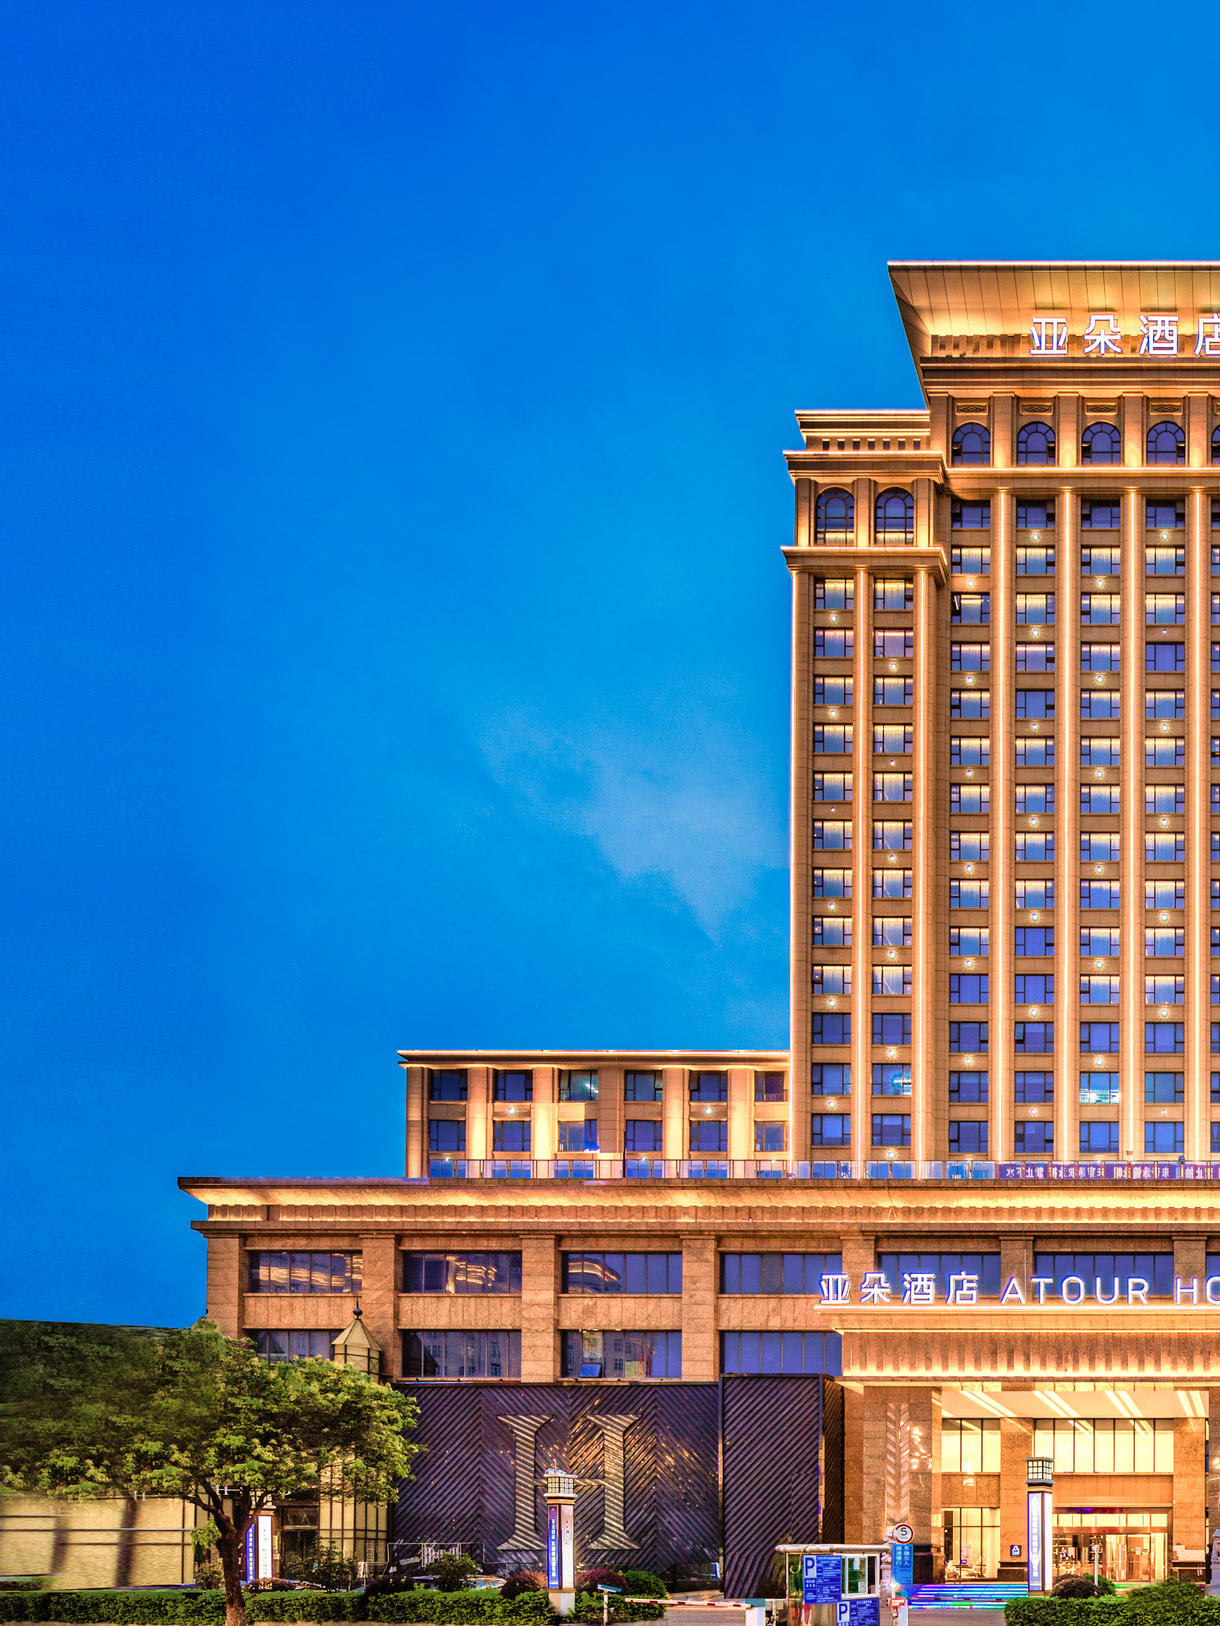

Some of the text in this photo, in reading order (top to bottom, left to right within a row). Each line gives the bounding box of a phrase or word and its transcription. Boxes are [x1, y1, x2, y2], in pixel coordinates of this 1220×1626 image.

[820, 1271, 979, 1305] 亚朵酒店
[1000, 1275, 1149, 1305] ATOUR
[900, 1527, 908, 1536] 5
[805, 1556, 815, 1577] P
[838, 1603, 848, 1621] P
